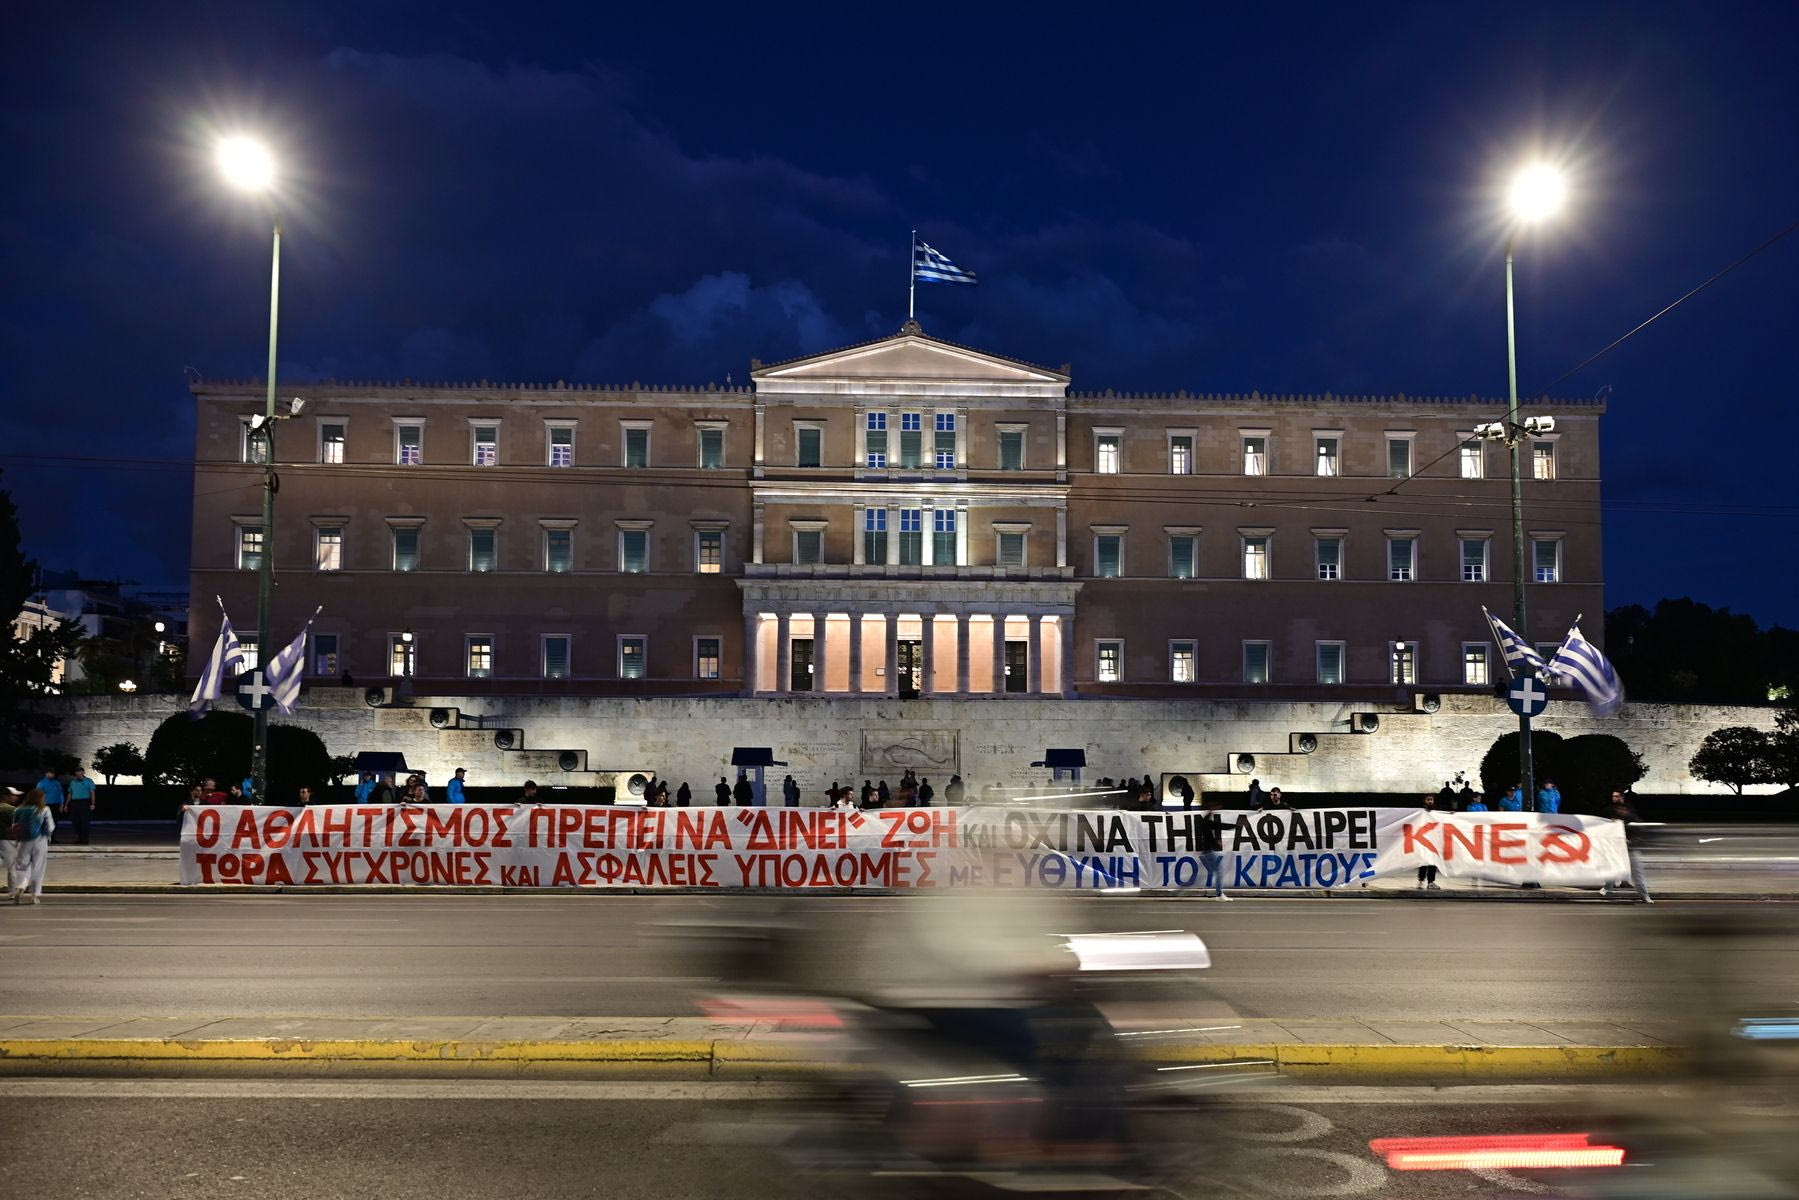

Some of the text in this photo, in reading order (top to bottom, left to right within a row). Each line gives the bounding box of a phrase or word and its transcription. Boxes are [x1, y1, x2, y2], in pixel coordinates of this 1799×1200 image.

[196, 808, 221, 848] Ο
[231, 807, 514, 849] ΑΘΛΗΤΙΣΜΟΣ
[528, 808, 667, 849] ΠΡΕΠΕΙ
[676, 810, 733, 850] ΝΑ
[879, 811, 958, 849] ΖΩΗ
[1004, 811, 1069, 851] ΟΧΙ
[1077, 813, 1135, 853] ΝΑ
[1232, 810, 1377, 852] ΑΦΑΙΡΕΙ
[1402, 822, 1529, 864] ΚΝΕ
[196, 852, 297, 885] ΤΩΡΑ
[303, 851, 492, 885] ΣΥΓΧΡΟΝΕΣ
[500, 865, 539, 887] ΚΑΙ
[552, 852, 720, 887] ΑΣΦΑΛΕΙΣ
[734, 851, 937, 888] ΥΠΟΔΟΜΕΣ
[993, 852, 1141, 888] ΕΥΘΥΝΗ
[1156, 855, 1223, 887] ΤΟΥ
[1233, 853, 1377, 888] ΚΡΑΤΟΥΣ
